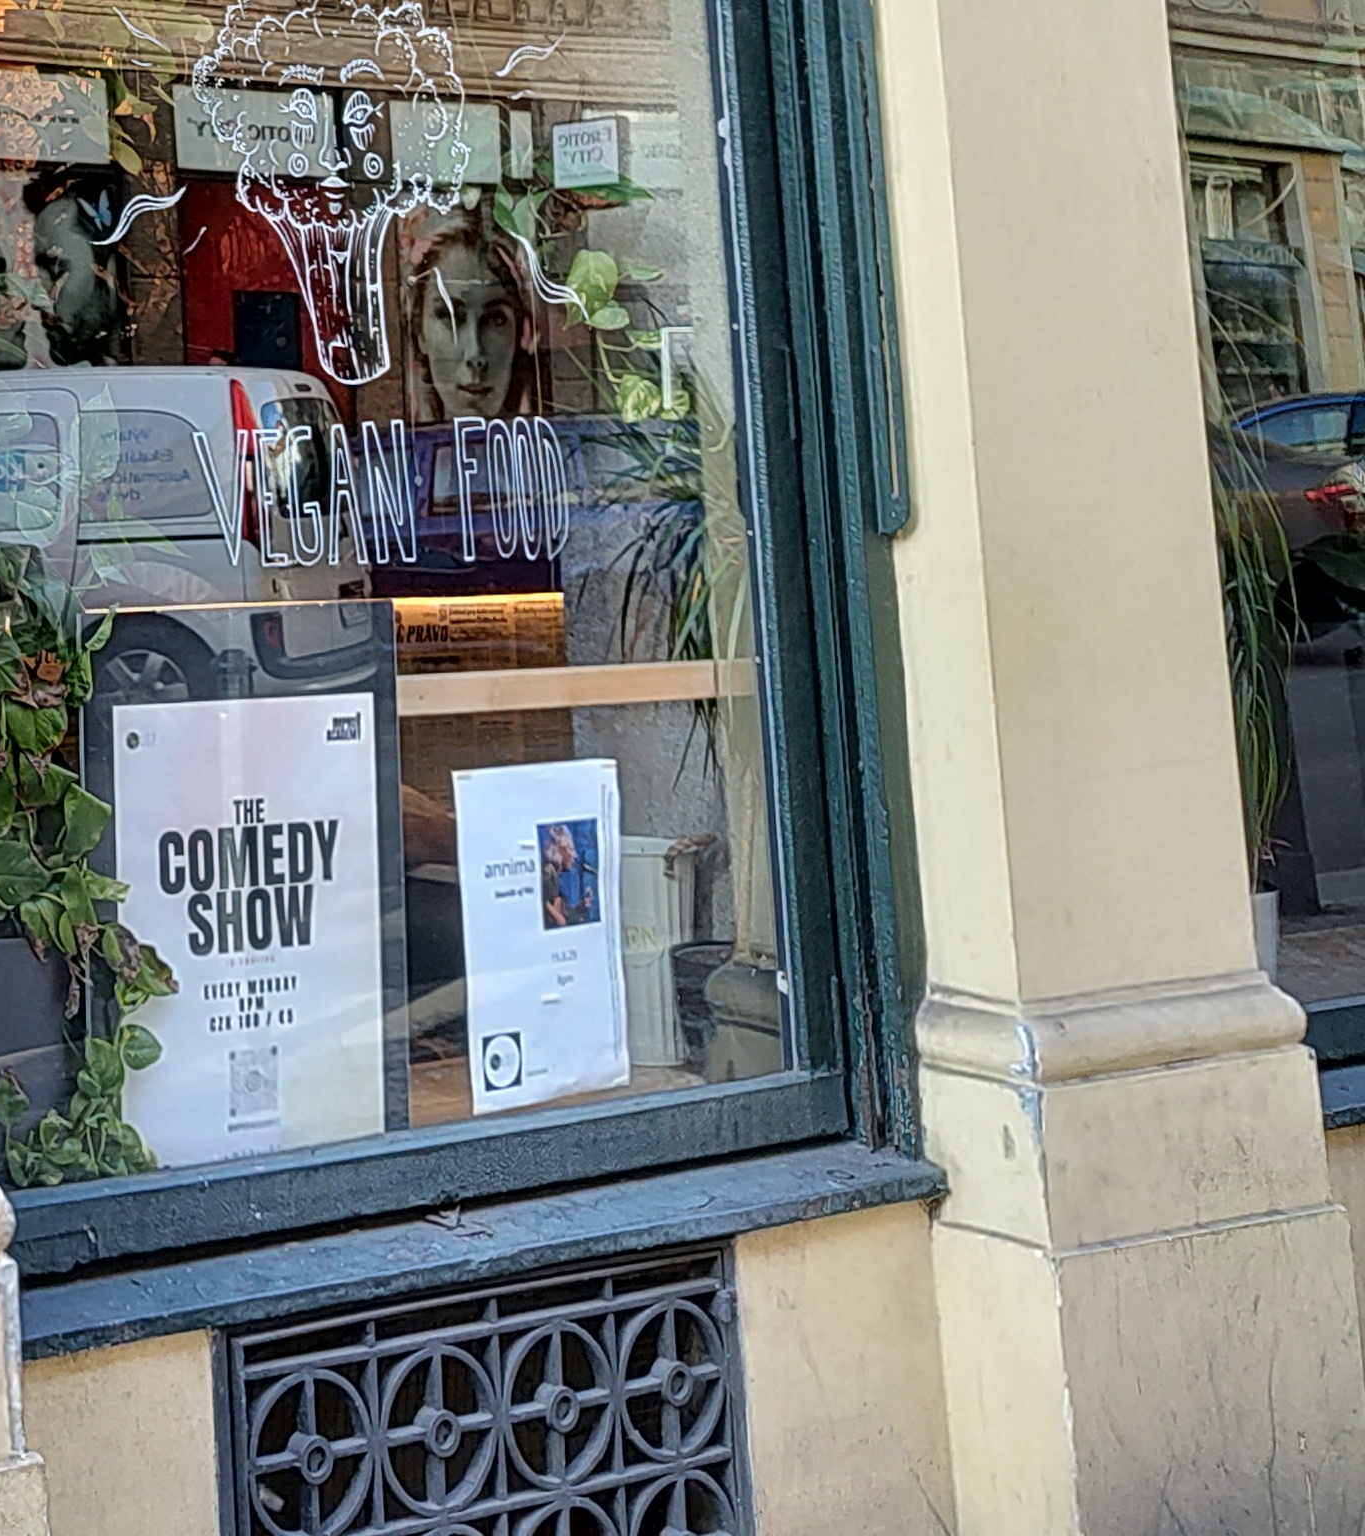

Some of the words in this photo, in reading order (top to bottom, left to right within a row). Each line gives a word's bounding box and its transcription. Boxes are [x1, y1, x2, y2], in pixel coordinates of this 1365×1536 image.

[194, 420, 419, 566] VEGAN
[454, 416, 571, 563] FOOD
[233, 798, 265, 825] THE
[159, 819, 339, 895] COMEDY
[187, 884, 314, 956] SHOW
[203, 981, 241, 1000] EVERY
[248, 975, 297, 995] MONDAY
